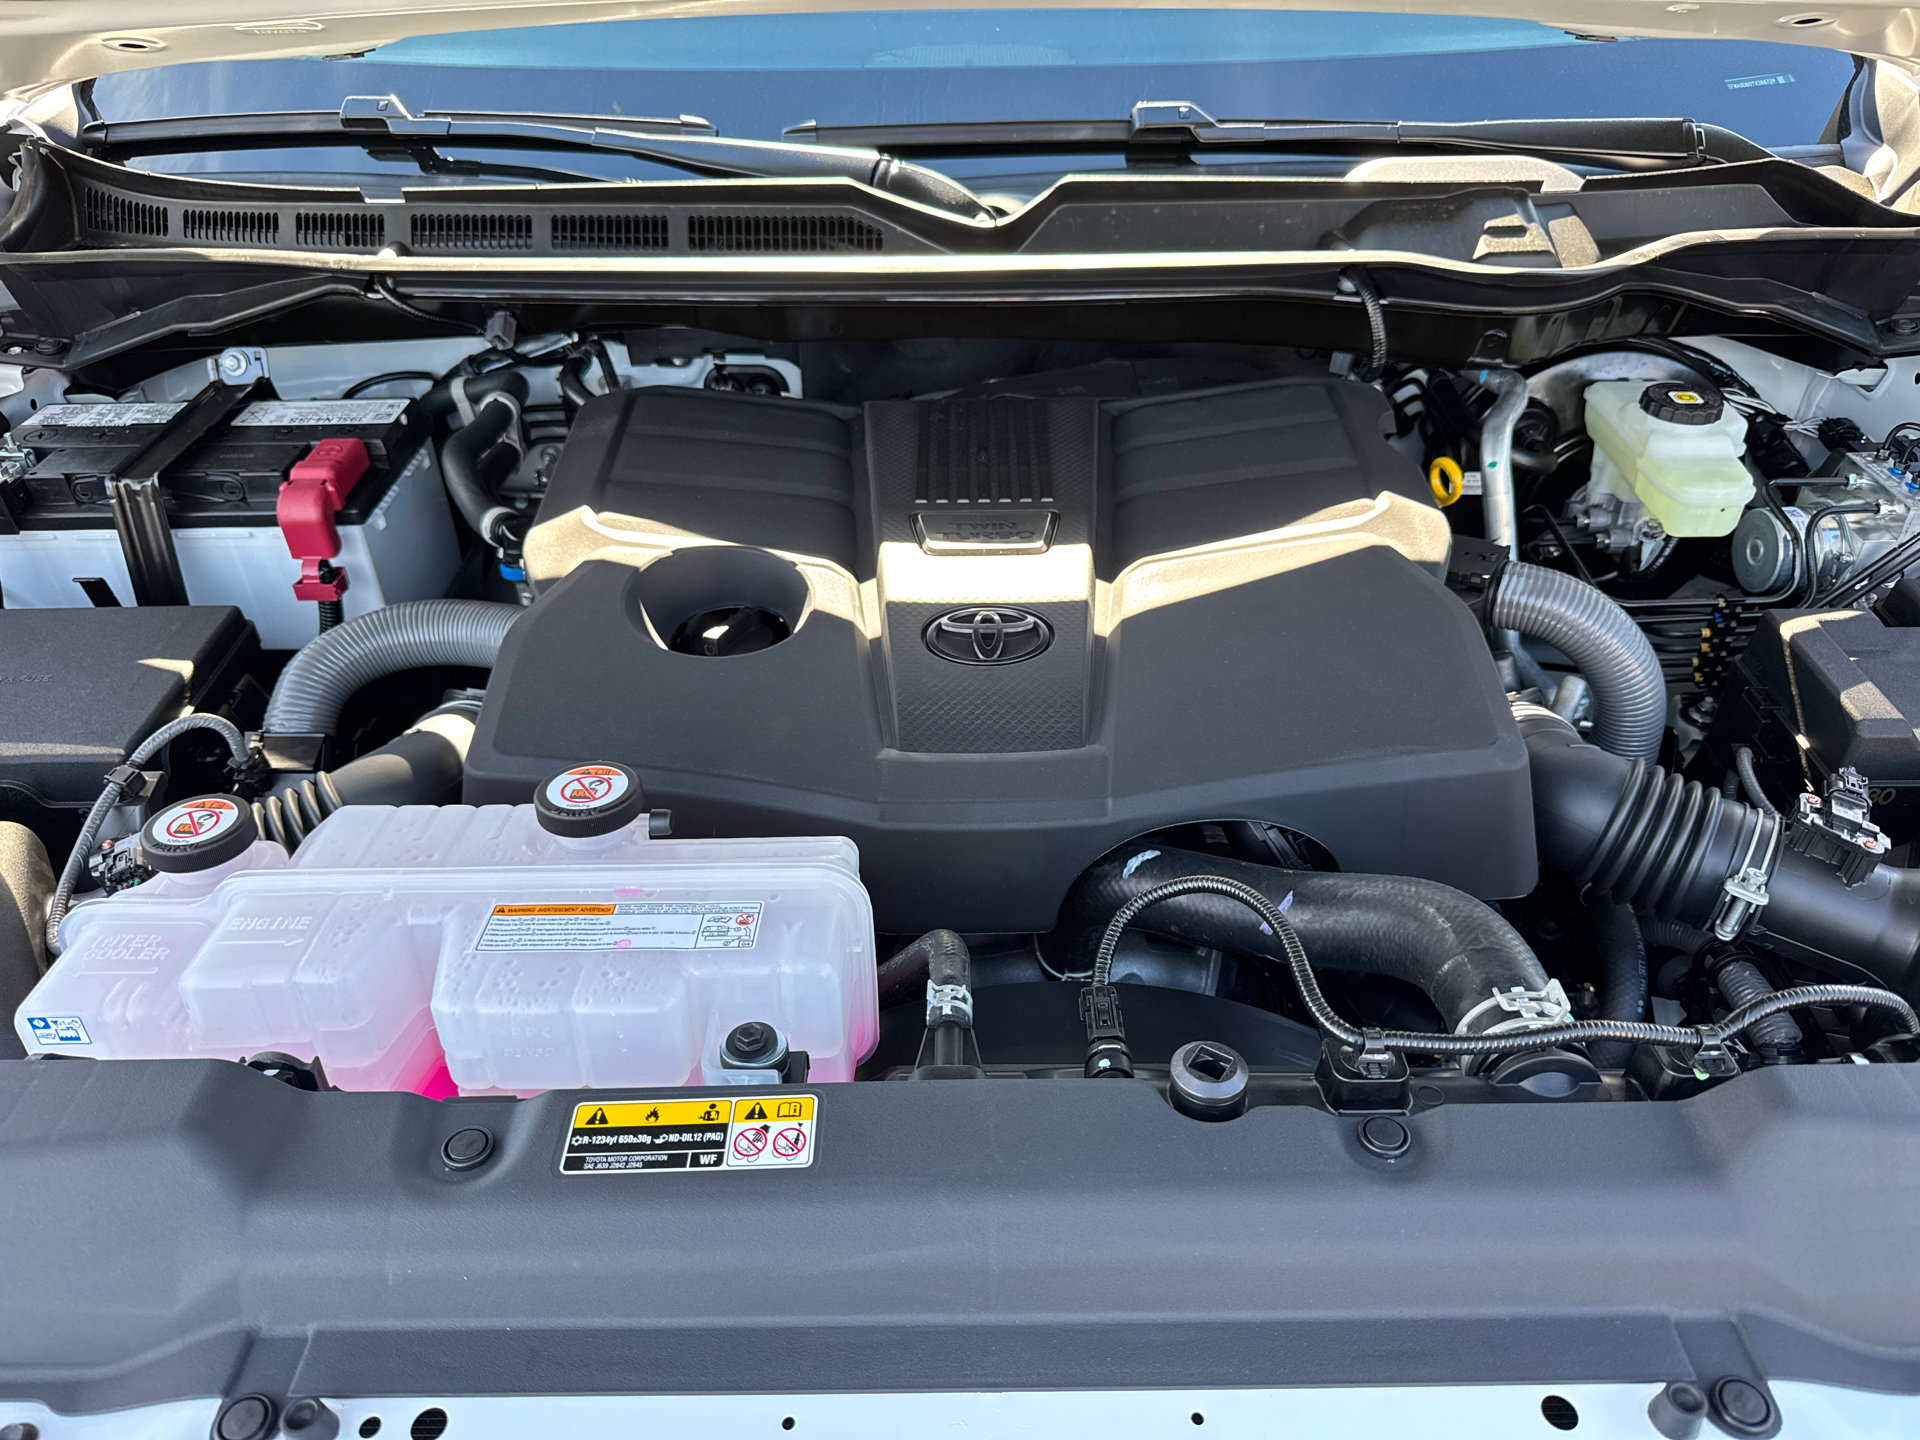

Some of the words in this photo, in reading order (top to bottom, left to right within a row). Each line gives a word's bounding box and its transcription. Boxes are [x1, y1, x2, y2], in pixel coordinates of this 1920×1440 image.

[948, 522, 1018, 530] TWIN
[936, 531, 1036, 540] TURBO
[226, 915, 314, 931] ENGINE
[91, 934, 163, 949] INTER
[583, 1135, 618, 1145] R-1234yf
[703, 1132, 724, 1143] (PAG)
[699, 1153, 718, 1166] WF
